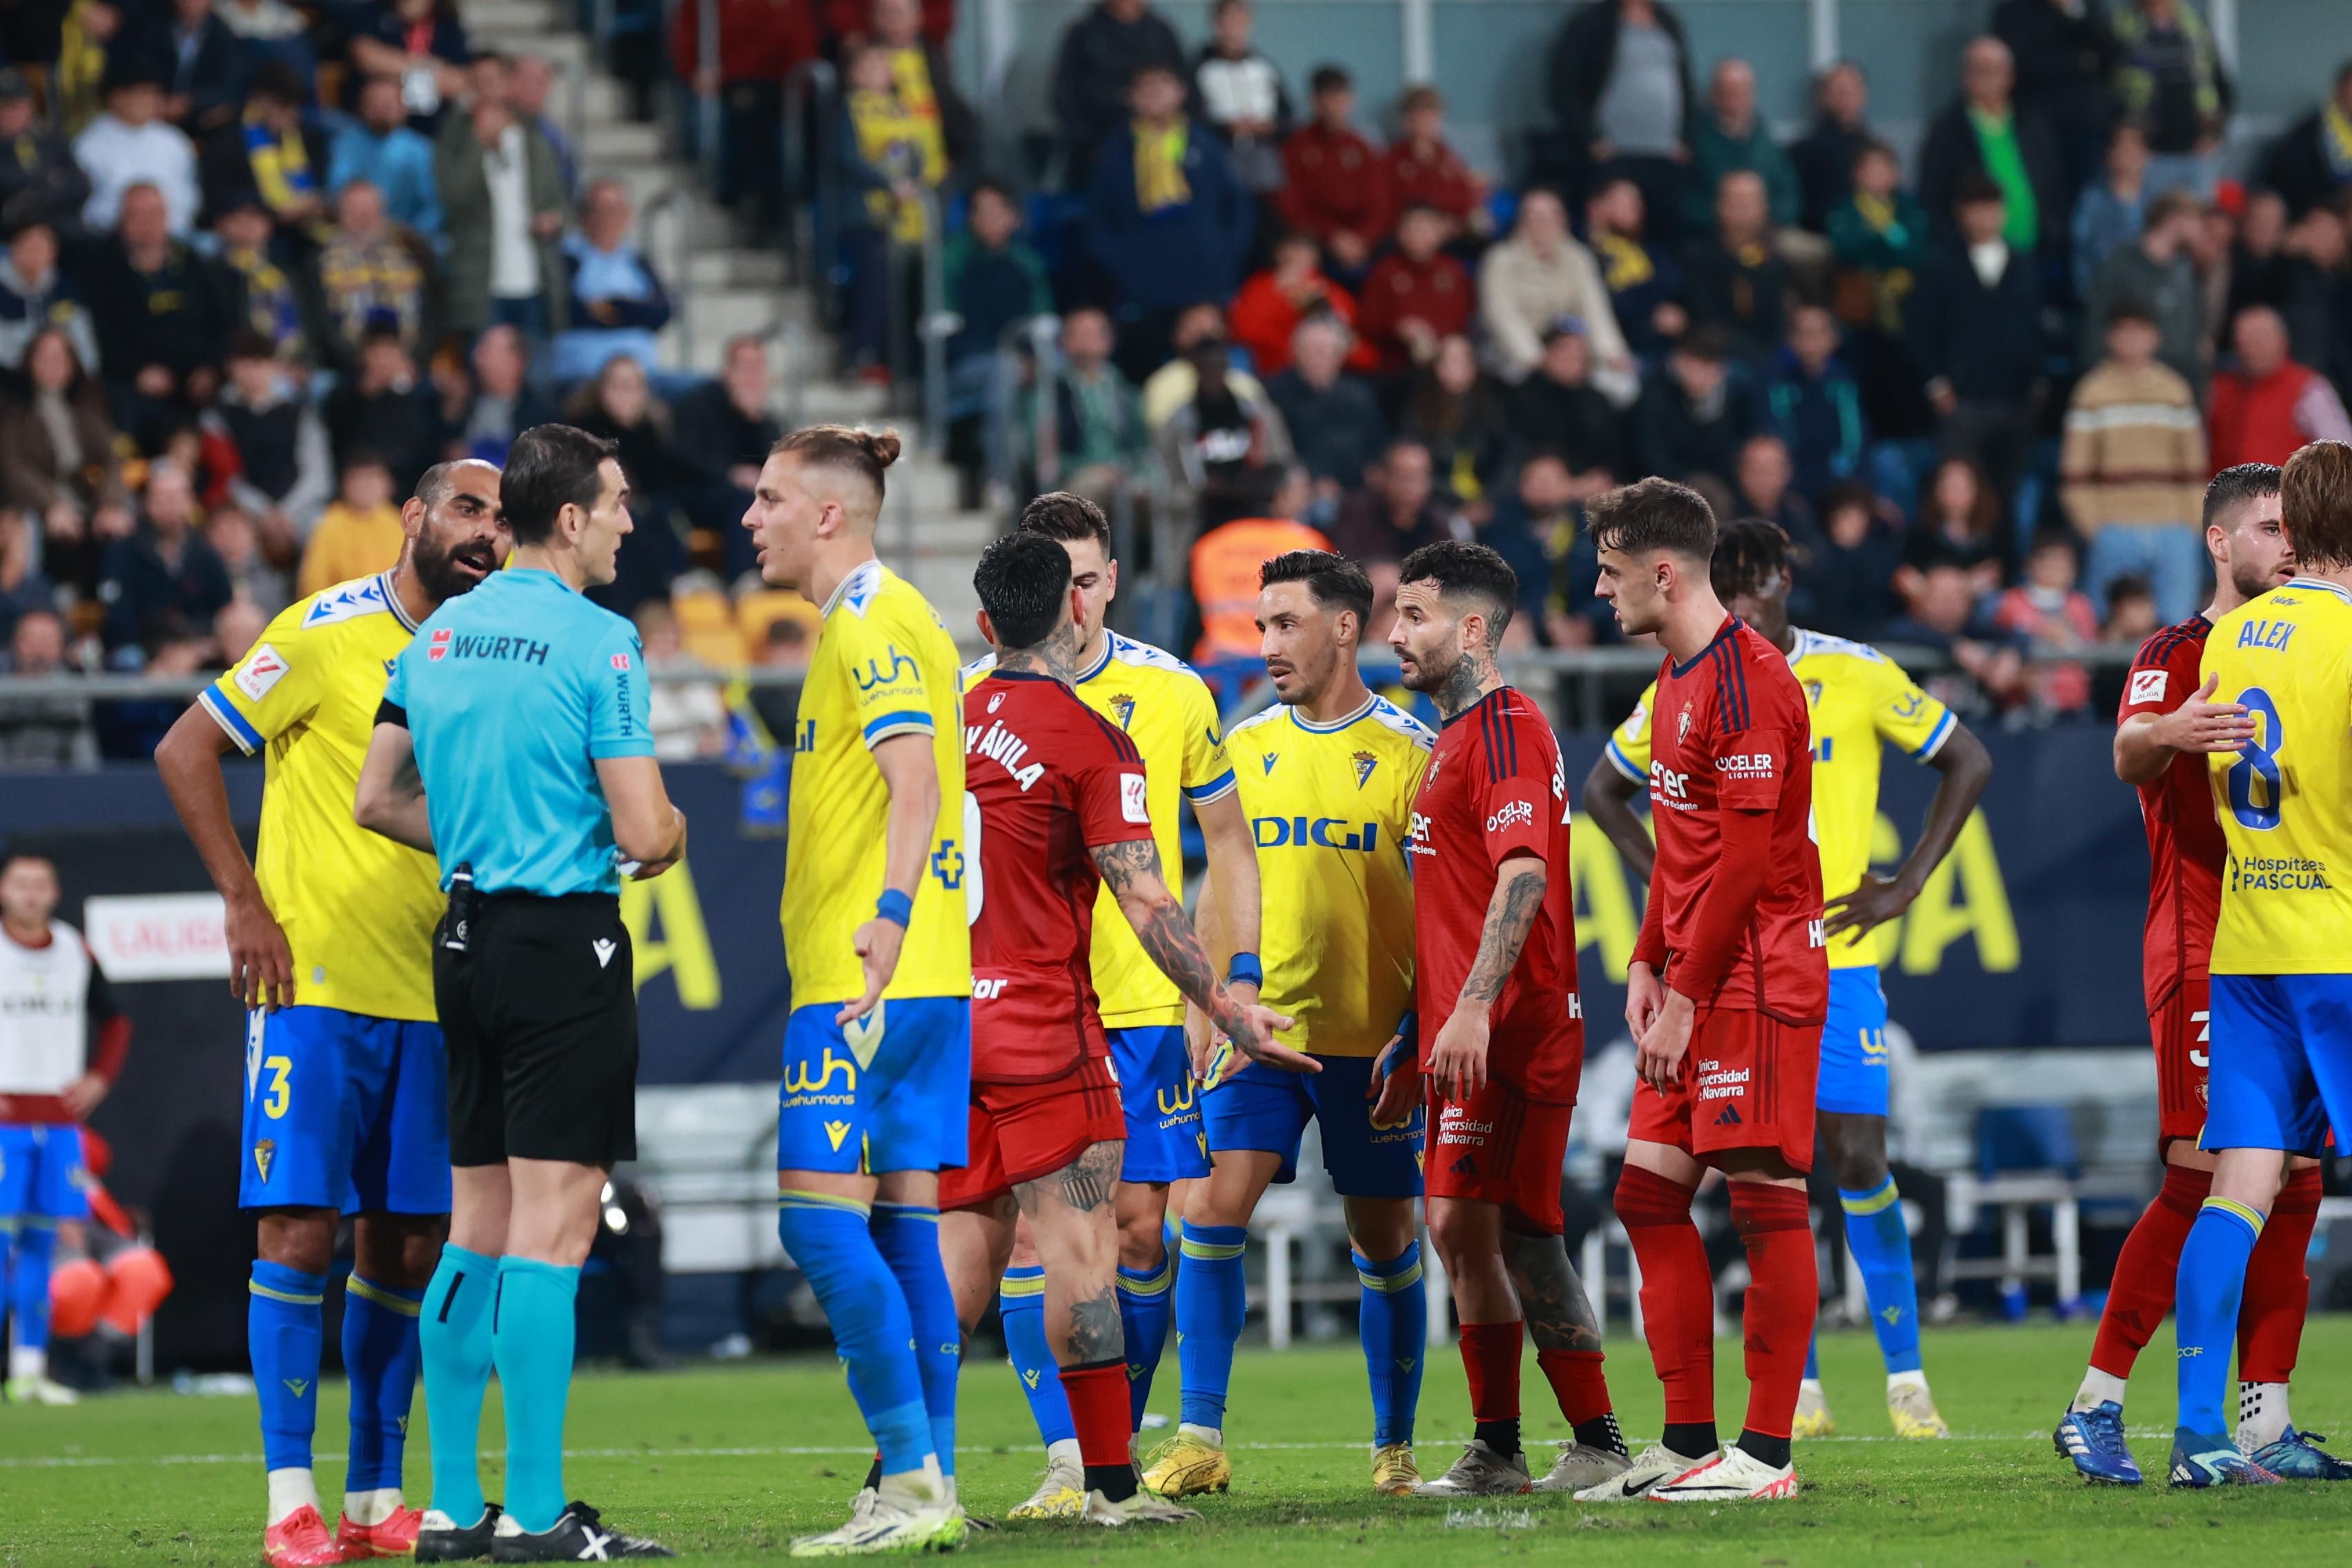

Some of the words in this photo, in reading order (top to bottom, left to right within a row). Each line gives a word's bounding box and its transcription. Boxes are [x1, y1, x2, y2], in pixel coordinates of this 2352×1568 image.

[2237, 620, 2297, 652] ALEX
[454, 635, 550, 666] WÜRTH
[616, 673, 632, 736] WÜRTH
[861, 687, 923, 707] wehumans
[2133, 691, 2159, 700] LALIGA
[977, 720, 1046, 792] ÁVILA
[2228, 686, 2284, 831] 8
[1252, 816, 1378, 852] DIGI
[2244, 873, 2333, 890] PASCUAL
[1698, 1068, 1750, 1086] niversidad
[264, 1056, 292, 1119] 3
[1703, 1086, 1744, 1101] Navarra
[782, 1095, 855, 1108] wehumans
[1370, 1128, 1425, 1143] wehumans
[1441, 1131, 1484, 1146] Navarra
